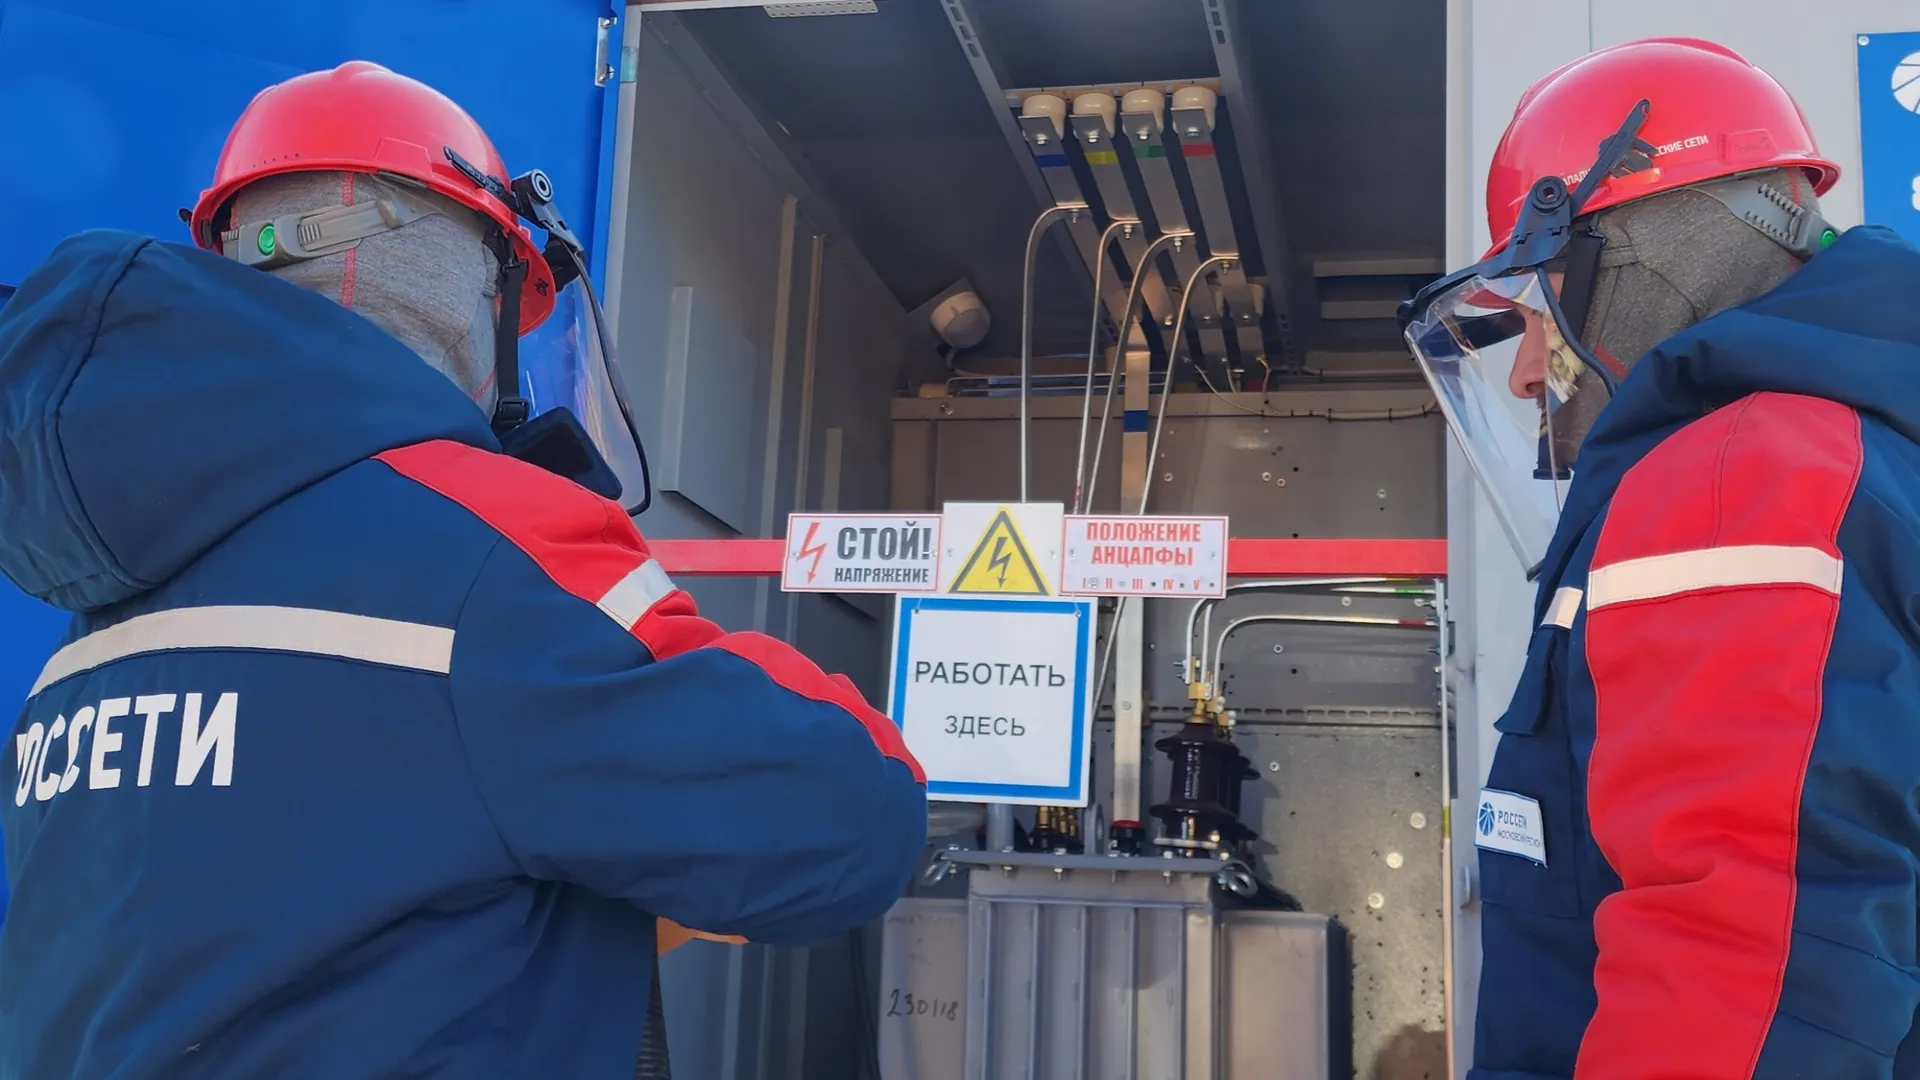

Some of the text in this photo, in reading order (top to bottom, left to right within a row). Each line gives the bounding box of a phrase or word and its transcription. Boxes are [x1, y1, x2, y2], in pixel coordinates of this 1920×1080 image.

[1684, 135, 1709, 148] СЕТИ
[837, 521, 932, 561] СТОЙ!
[1086, 522, 1201, 542] ПОЛОЖЕНИЕ
[1091, 546, 1194, 568] АНЦАПФЫ
[834, 567, 929, 583] НАПРЯЖЕНИЕ
[915, 661, 1066, 687] РАБОТАТЬ
[944, 715, 1026, 739] ЗДЕСЬ
